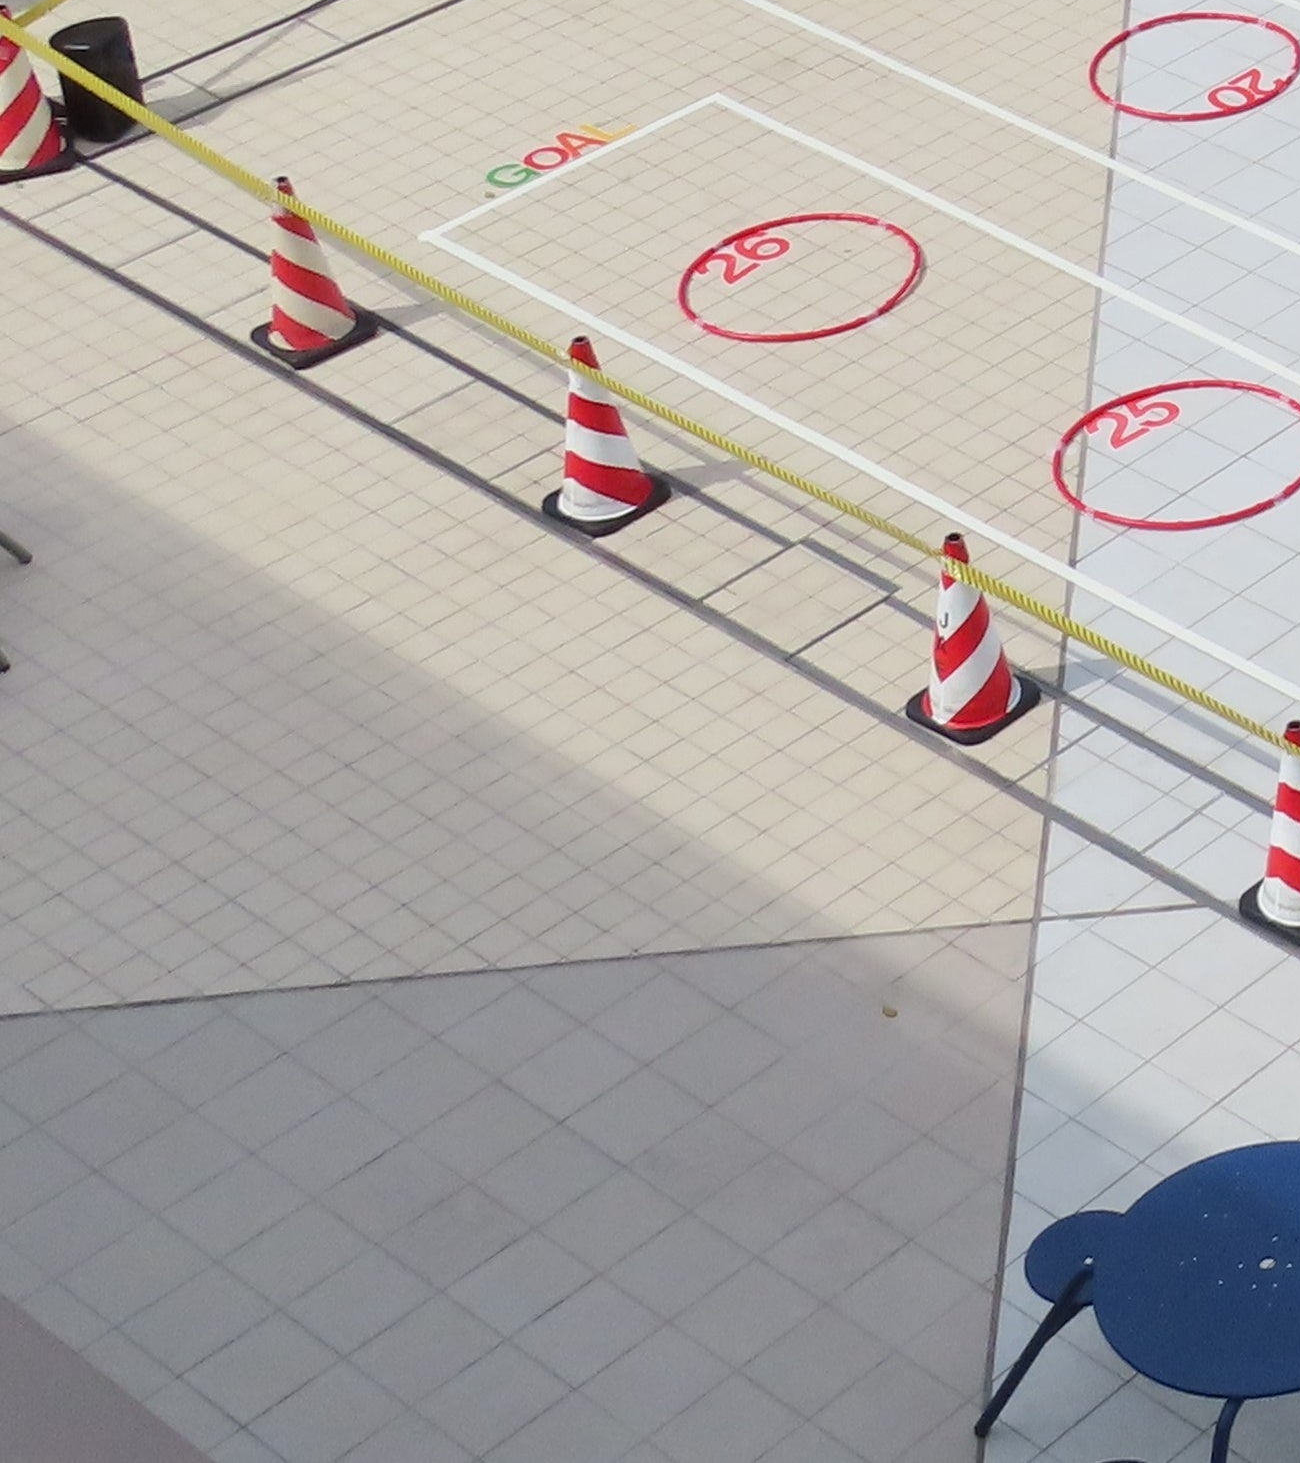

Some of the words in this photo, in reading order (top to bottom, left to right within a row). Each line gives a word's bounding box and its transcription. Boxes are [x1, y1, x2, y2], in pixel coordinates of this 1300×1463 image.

[1208, 69, 1286, 112] 20
[486, 123, 638, 189] GOAL
[694, 232, 791, 285] 26
[1084, 401, 1181, 450] 25
